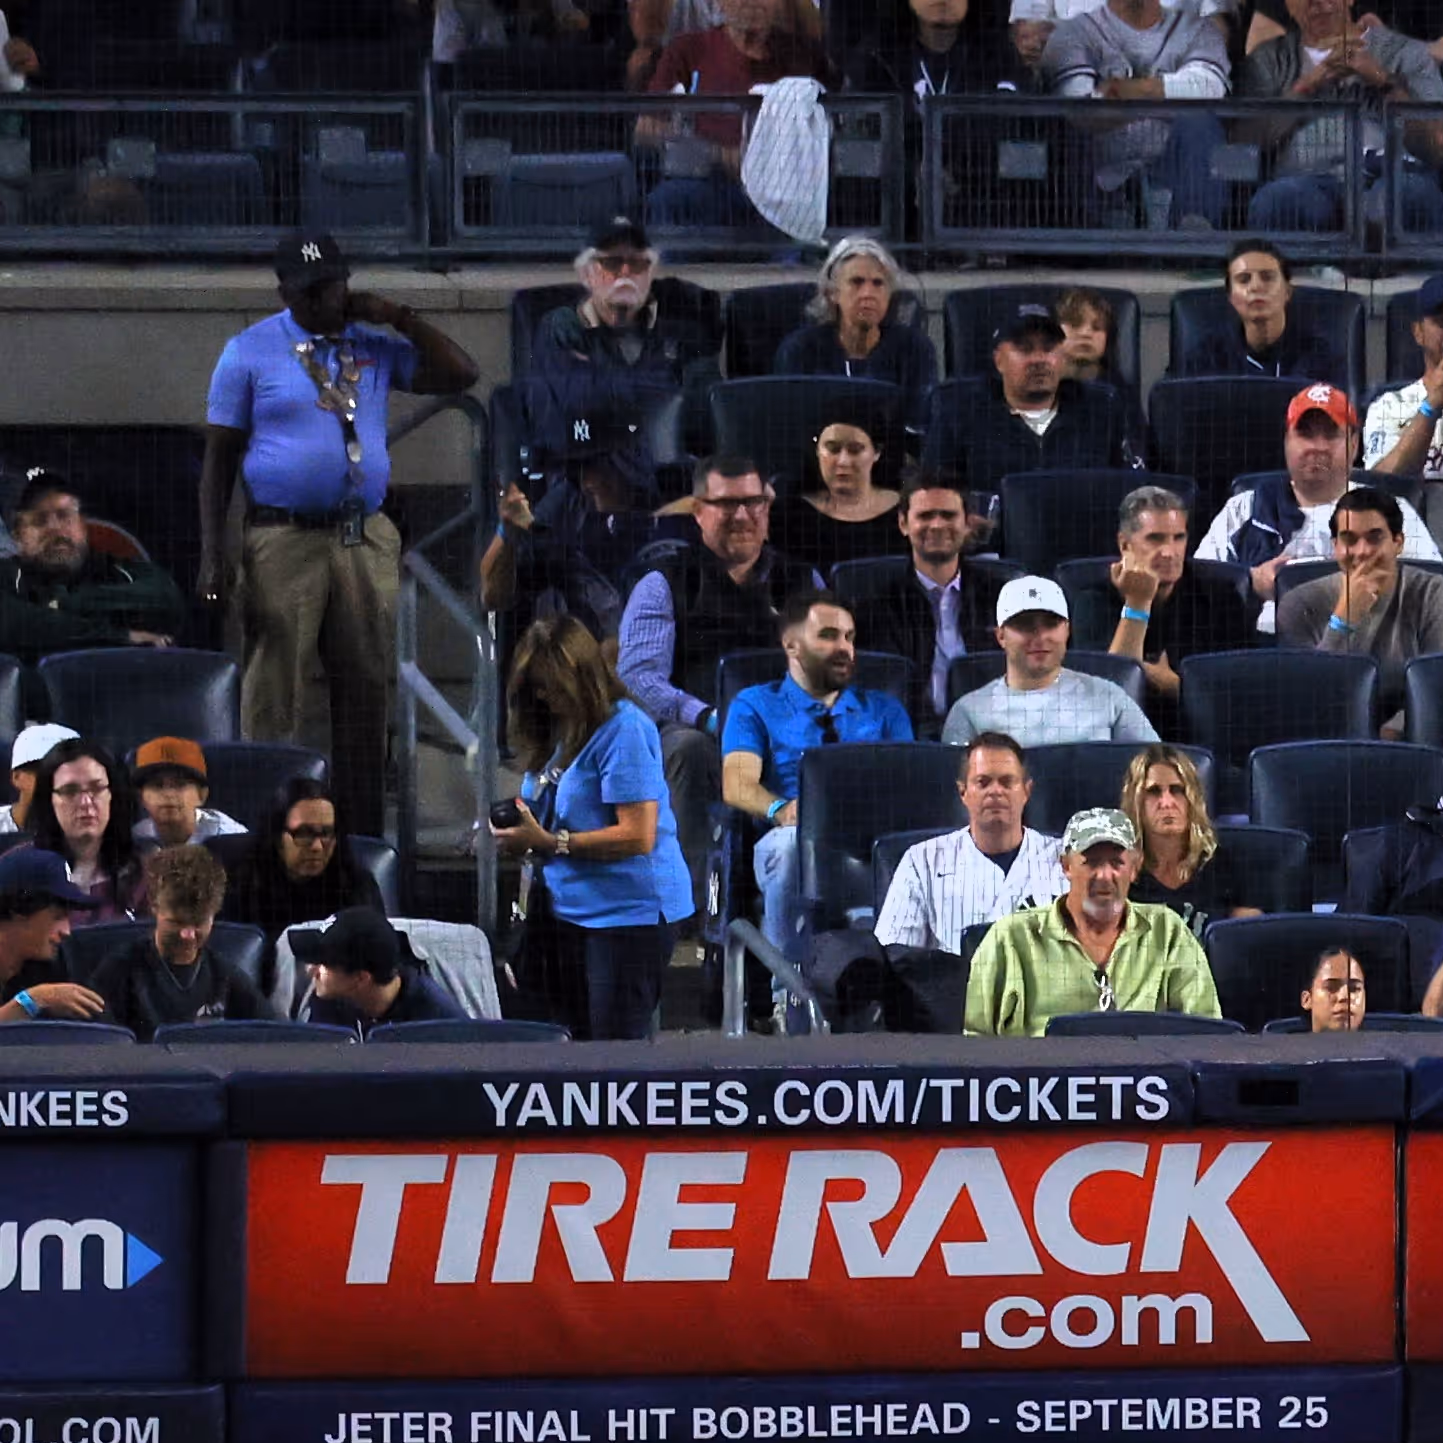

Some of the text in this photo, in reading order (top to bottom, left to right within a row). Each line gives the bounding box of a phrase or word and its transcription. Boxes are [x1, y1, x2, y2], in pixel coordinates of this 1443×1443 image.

[483, 1076, 1169, 1127] YANKEES.COM/TICKETS
[320, 1141, 1311, 1344] TIRE RACK
[961, 1292, 1213, 1349] .com
[470, 1410, 591, 1443] FINAL
[608, 1408, 676, 1441] HIT
[692, 1402, 971, 1439] BOBBLEHEAD
[1016, 1397, 1261, 1433] SEPTEMBER
[1278, 1396, 1328, 1428] 25
